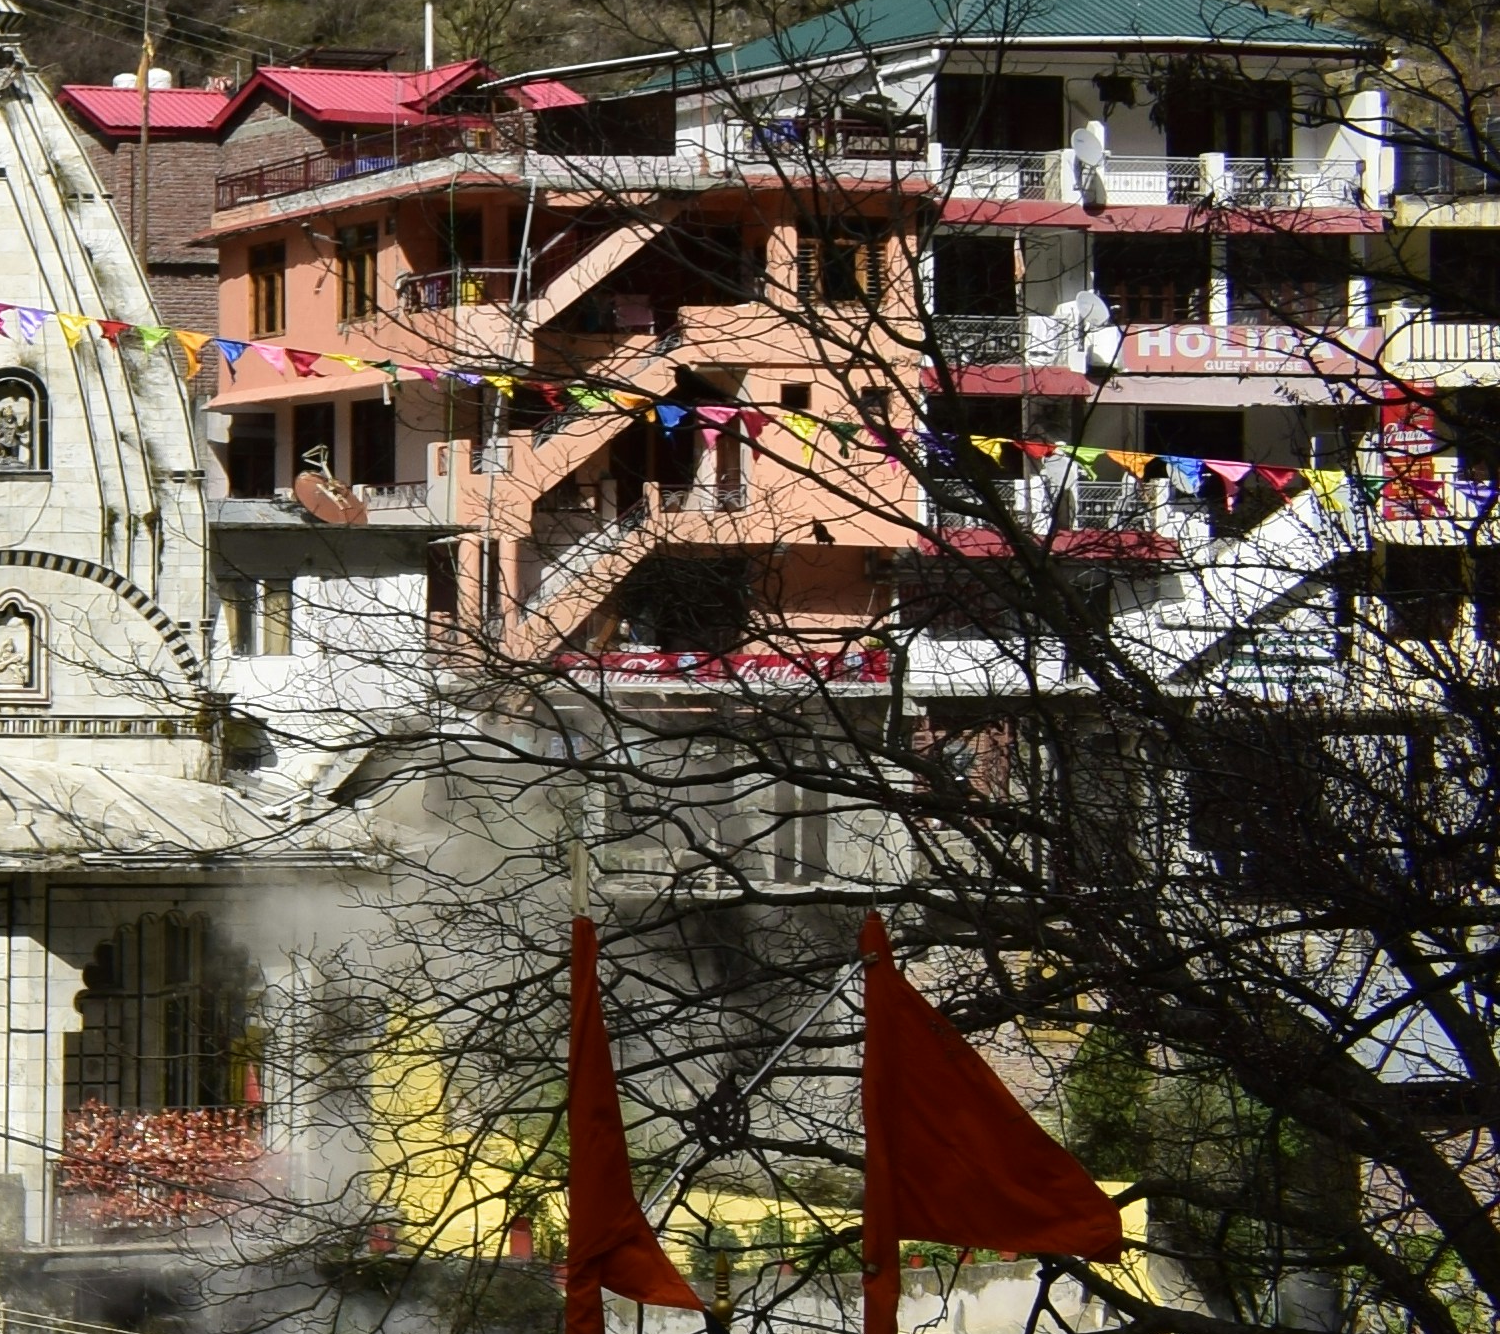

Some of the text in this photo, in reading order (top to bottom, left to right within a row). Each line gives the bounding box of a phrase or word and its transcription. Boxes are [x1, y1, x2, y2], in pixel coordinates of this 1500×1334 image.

[1137, 327, 1372, 359] HOLIDAY
[1204, 360, 1303, 371] GUEST HOUSE
